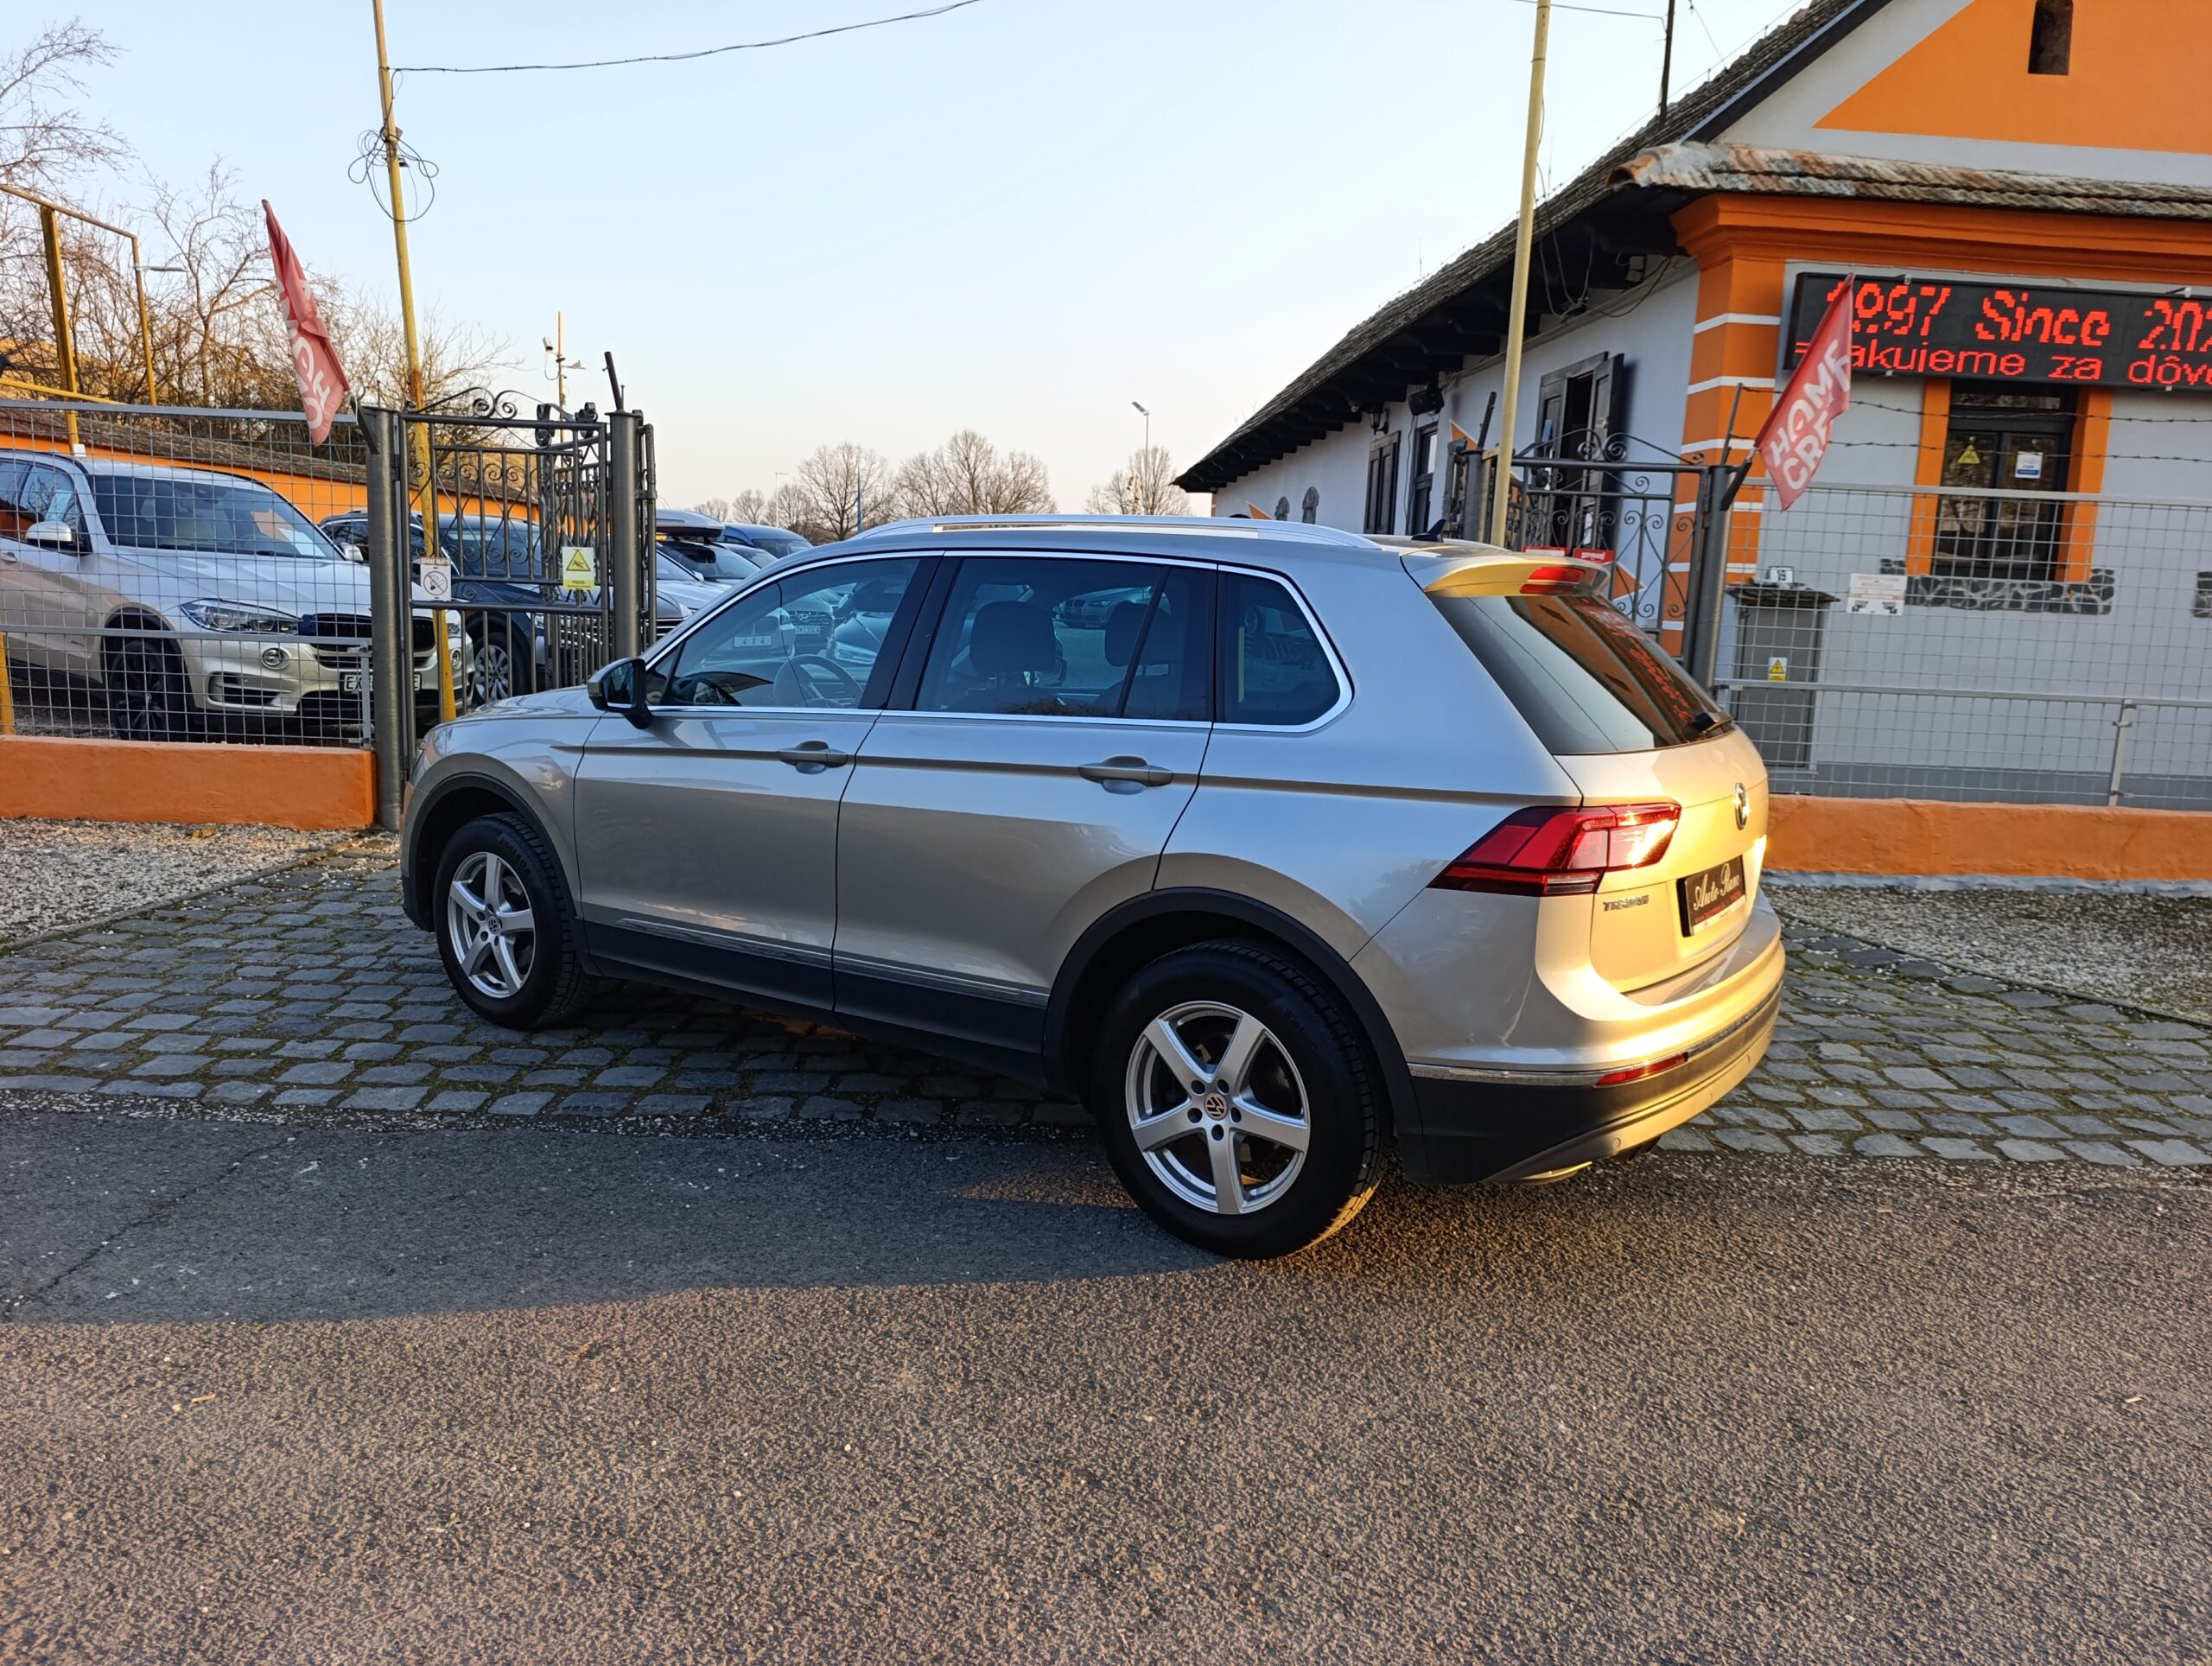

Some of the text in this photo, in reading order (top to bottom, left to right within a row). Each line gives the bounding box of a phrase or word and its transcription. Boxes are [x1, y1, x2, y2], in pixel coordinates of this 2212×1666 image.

[1975, 290, 2110, 346] Since
[2048, 355, 2103, 380] za
[1694, 874, 1720, 911] Auto
